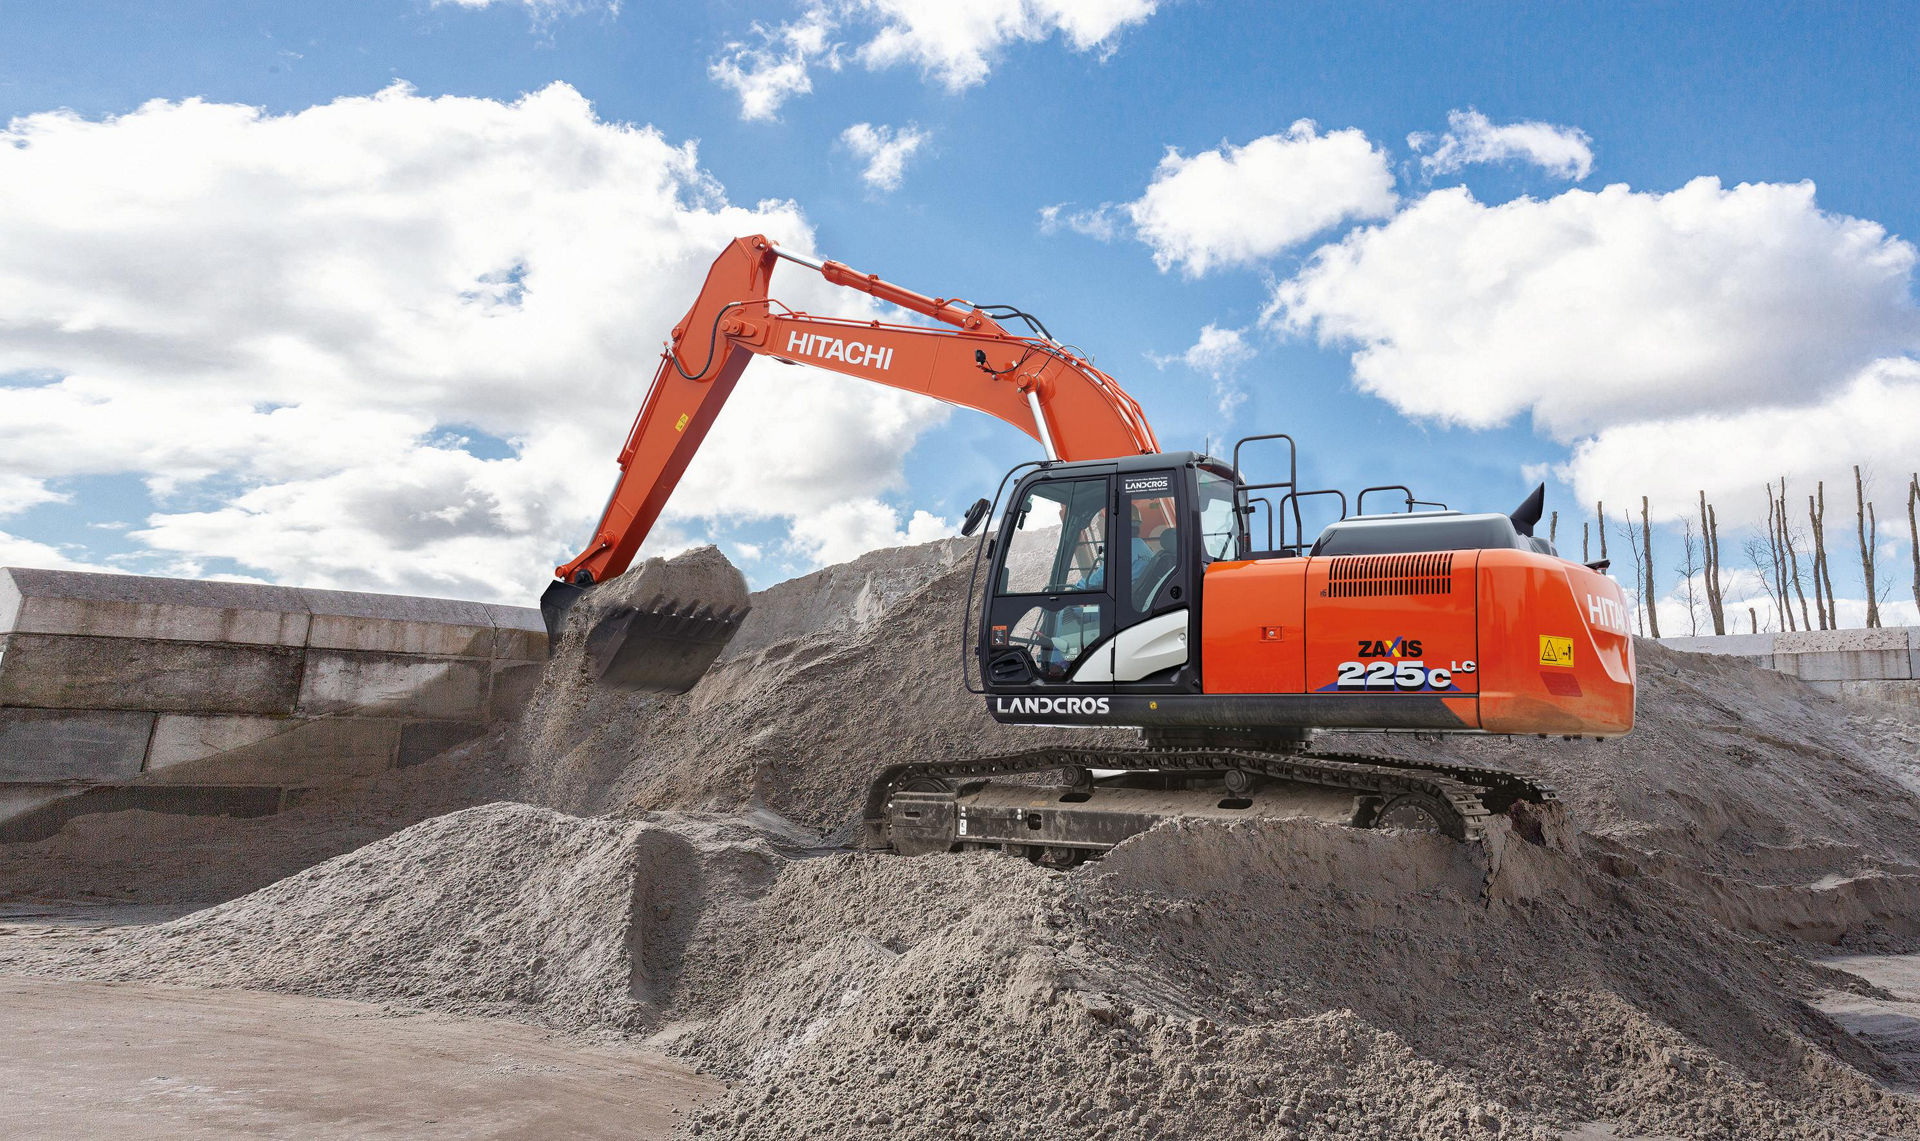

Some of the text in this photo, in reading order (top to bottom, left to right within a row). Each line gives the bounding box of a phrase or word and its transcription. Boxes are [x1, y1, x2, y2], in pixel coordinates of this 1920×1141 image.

[786, 330, 894, 371] HITACHI
[1125, 480, 1168, 490] LANDCROS
[1358, 636, 1423, 658] ZAXIS
[997, 697, 1110, 714] LANDCROS
